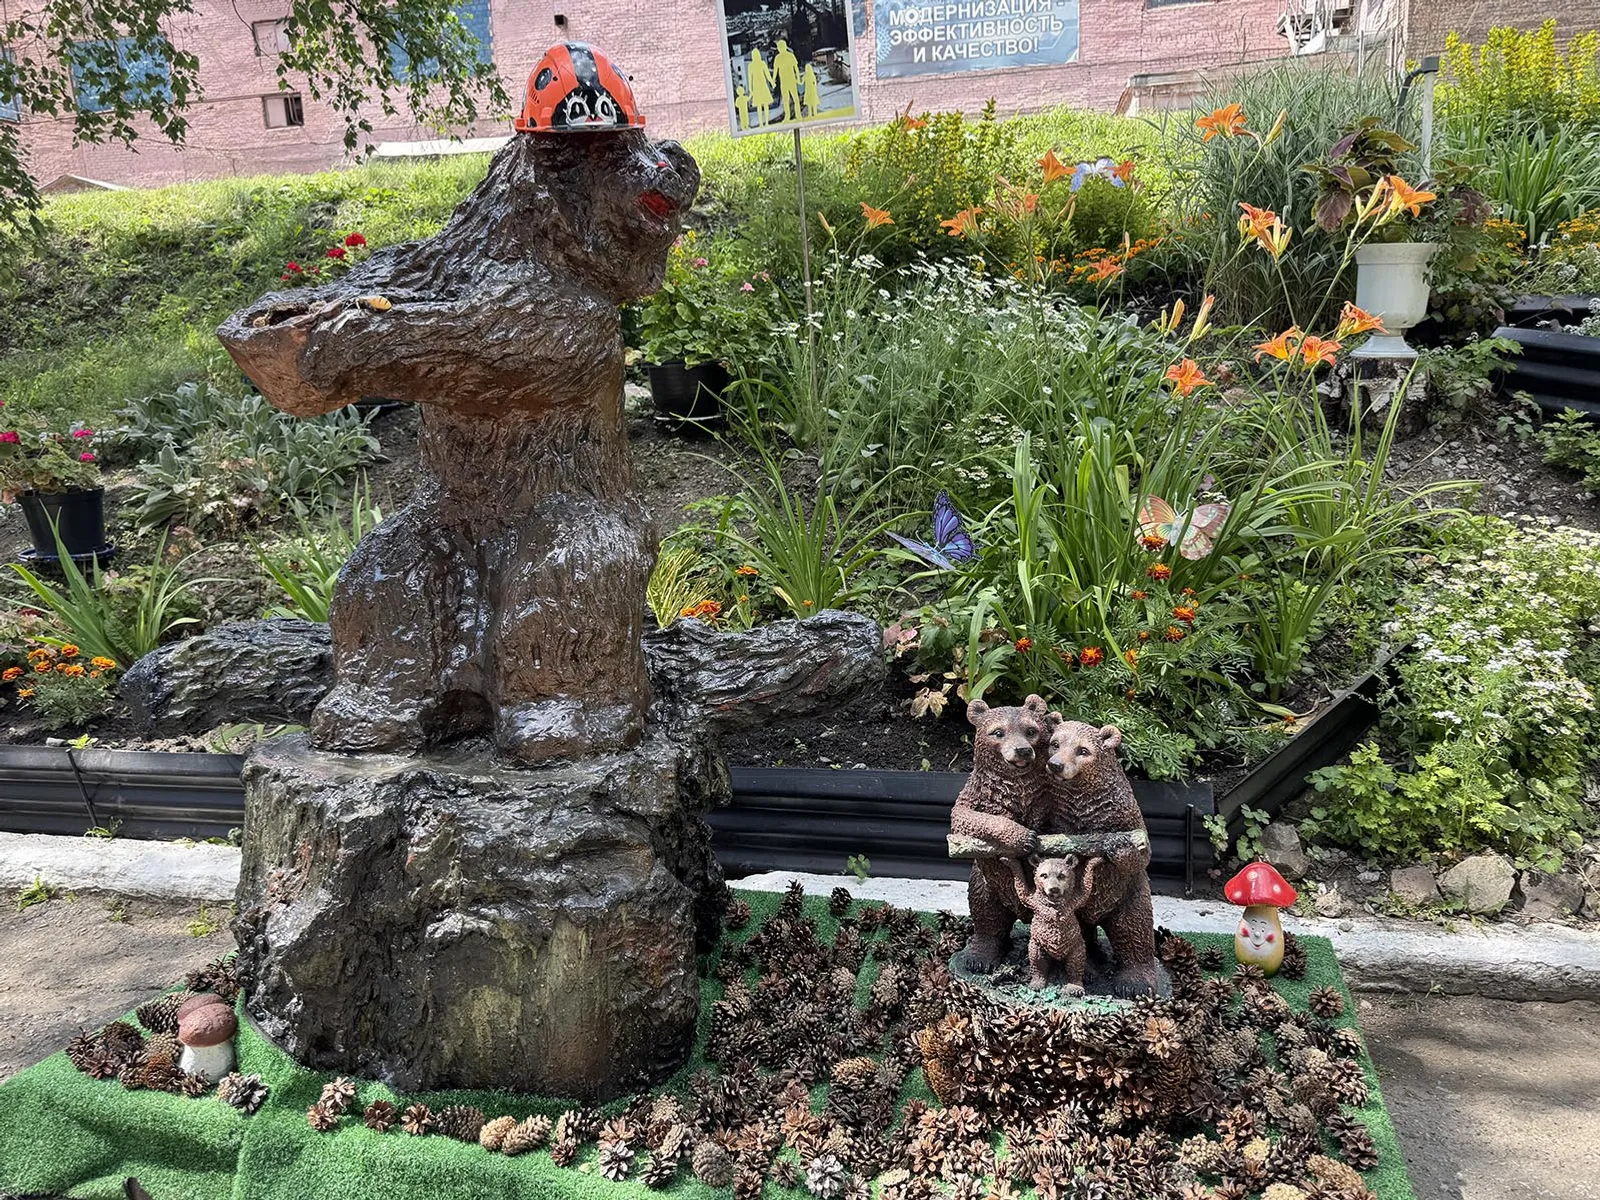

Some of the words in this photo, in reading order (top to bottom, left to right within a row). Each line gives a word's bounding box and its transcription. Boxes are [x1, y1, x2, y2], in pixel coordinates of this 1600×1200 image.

[889, 0, 1052, 26] МОДЕРНИЗАЦИЯ
[889, 15, 1063, 45] ЭФФЕКТИВНОСТЬ
[913, 47, 926, 63] И
[931, 37, 1038, 61] КАЧЕСТВО!
